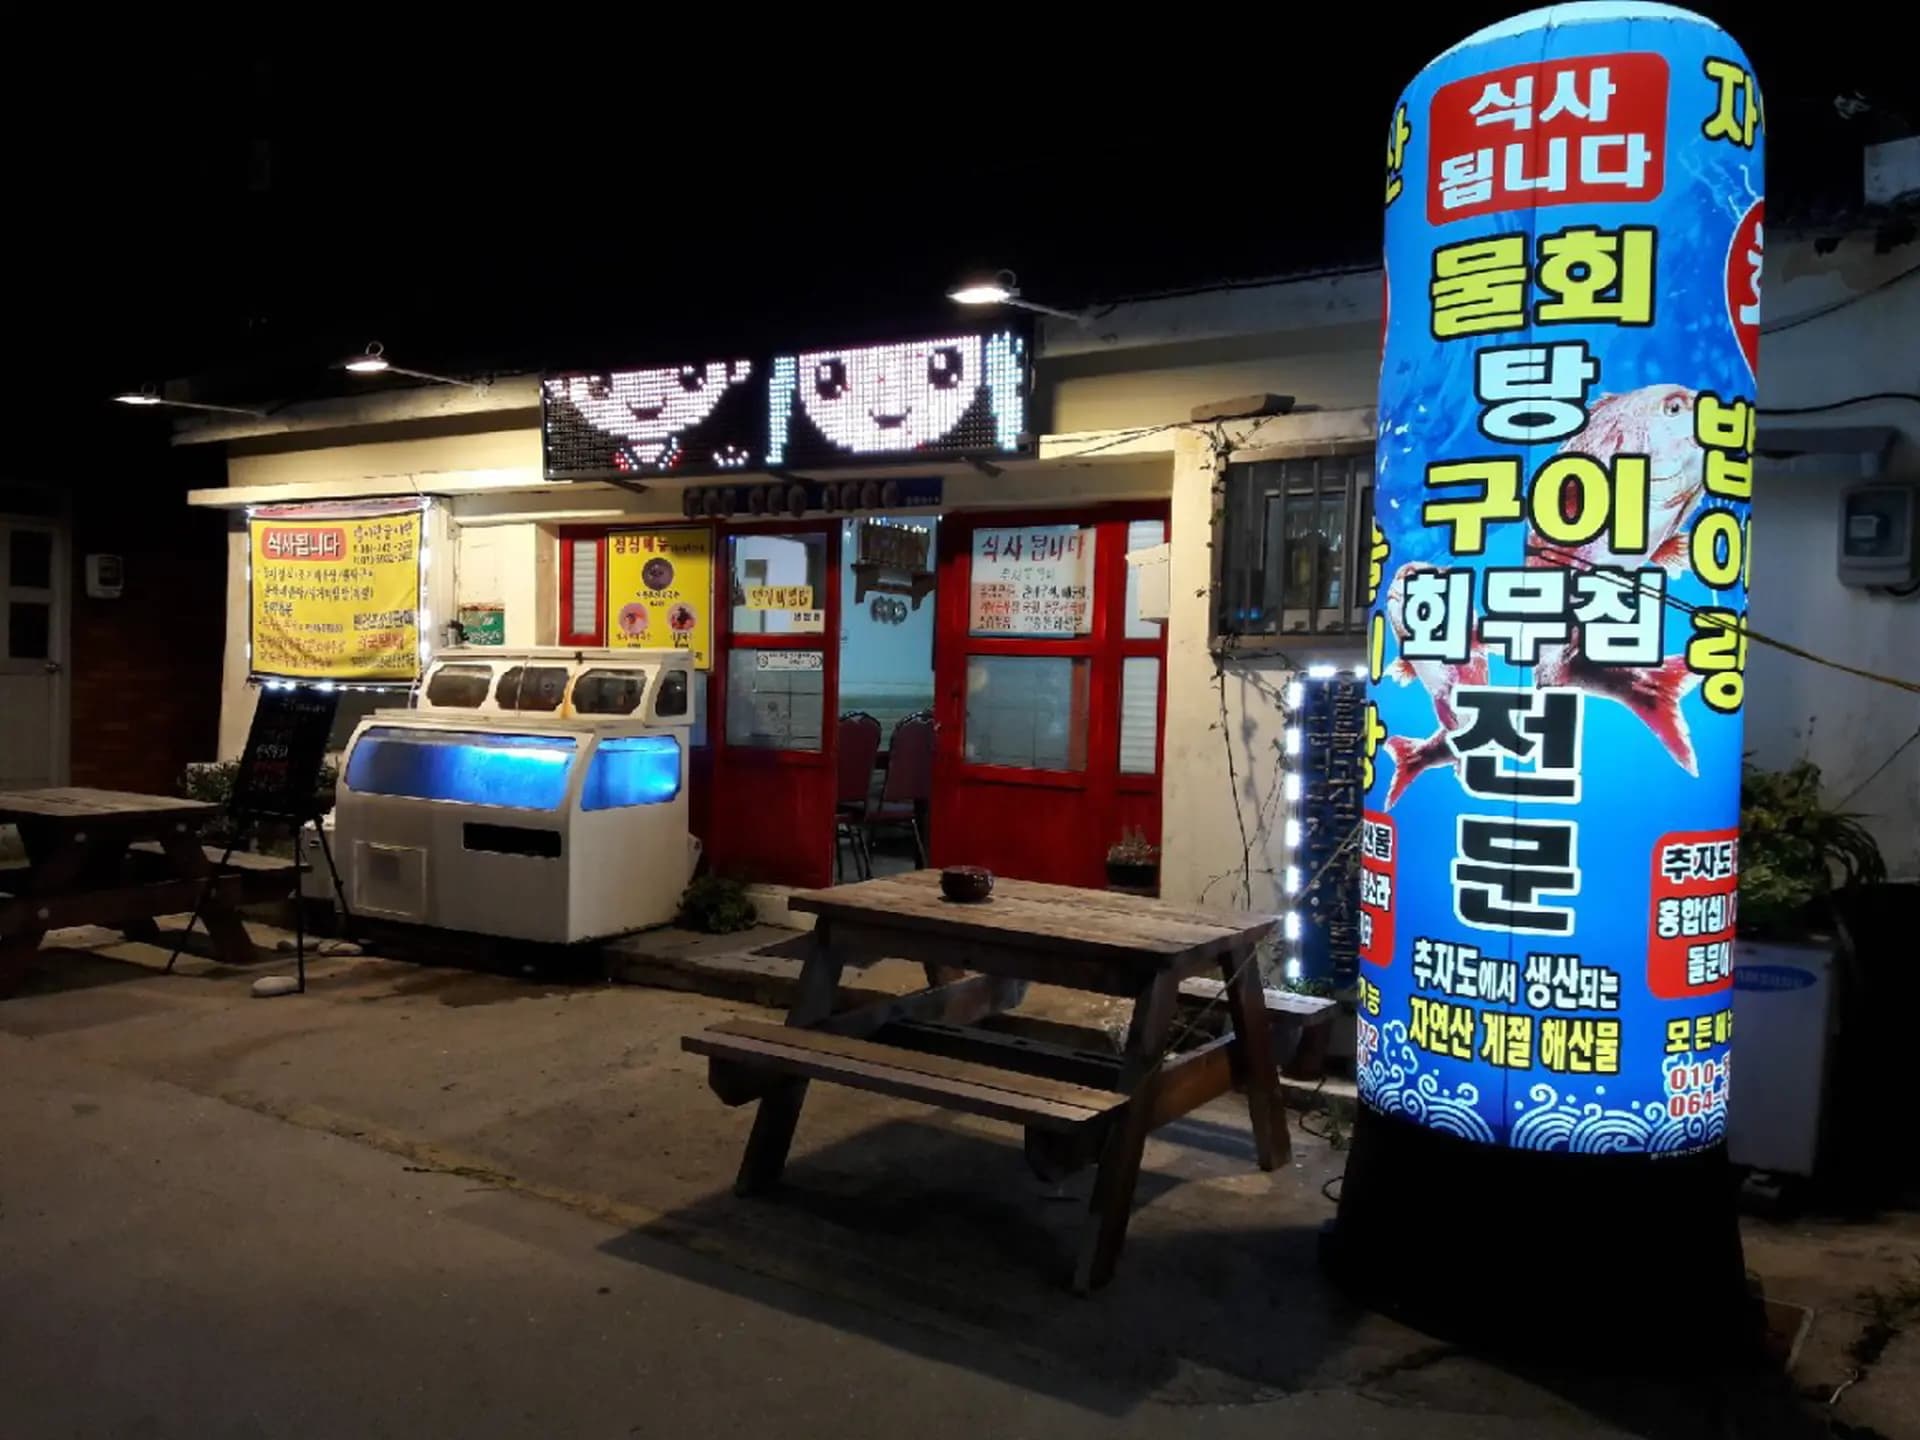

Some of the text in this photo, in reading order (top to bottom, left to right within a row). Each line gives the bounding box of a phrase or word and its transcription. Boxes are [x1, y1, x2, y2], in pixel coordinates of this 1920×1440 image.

[1468, 66, 1617, 131] 식사
[1438, 132, 1652, 211] 됩니다
[1430, 226, 1657, 341] 물회
[1476, 341, 1600, 443] 탕
[1423, 453, 1650, 554] 구이
[267, 532, 340, 557] 식사됩니다
[982, 534, 1085, 562] 식사 됩니다
[1401, 565, 1667, 669] 회무침
[1447, 685, 1583, 936] 전문
[1360, 869, 1392, 912] 소라
[1413, 937, 1621, 1012] 추자도에서 생산되는
[1407, 996, 1475, 1060] 자연산
[1479, 1010, 1534, 1072] 계절
[1540, 1018, 1621, 1077] 해산물
[1666, 1074, 1730, 1119] 064-
